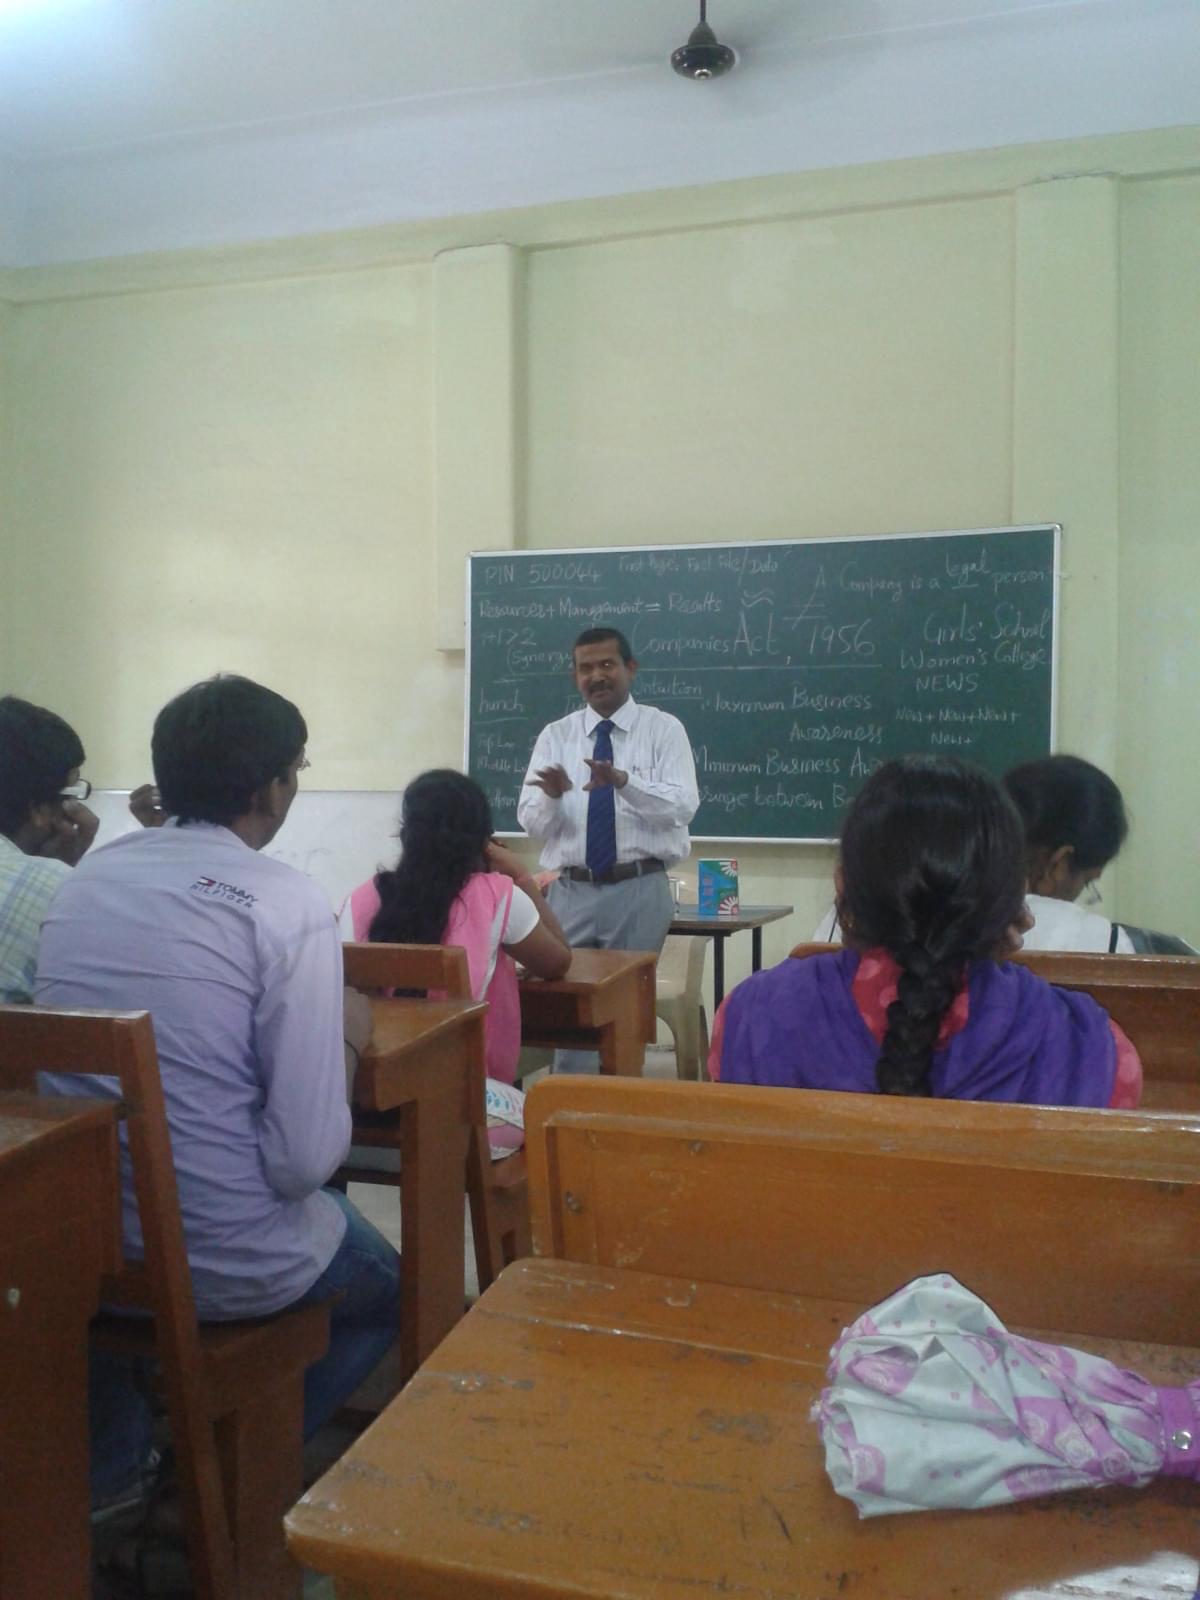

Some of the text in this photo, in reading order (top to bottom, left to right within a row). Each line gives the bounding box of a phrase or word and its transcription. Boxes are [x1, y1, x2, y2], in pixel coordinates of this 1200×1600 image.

[485, 561, 604, 585] PIN 500044
[838, 560, 903, 602] Company
[989, 600, 1050, 640] School
[632, 616, 730, 657] Companies
[808, 618, 876, 657] 1956
[899, 638, 1049, 671] Women's College
[791, 682, 873, 713] Business
[914, 671, 980, 694] NEWS
[478, 687, 525, 715] hunch
[789, 720, 884, 745] Awareness
[765, 747, 841, 777] Business
[216, 882, 259, 902] TOMMY
